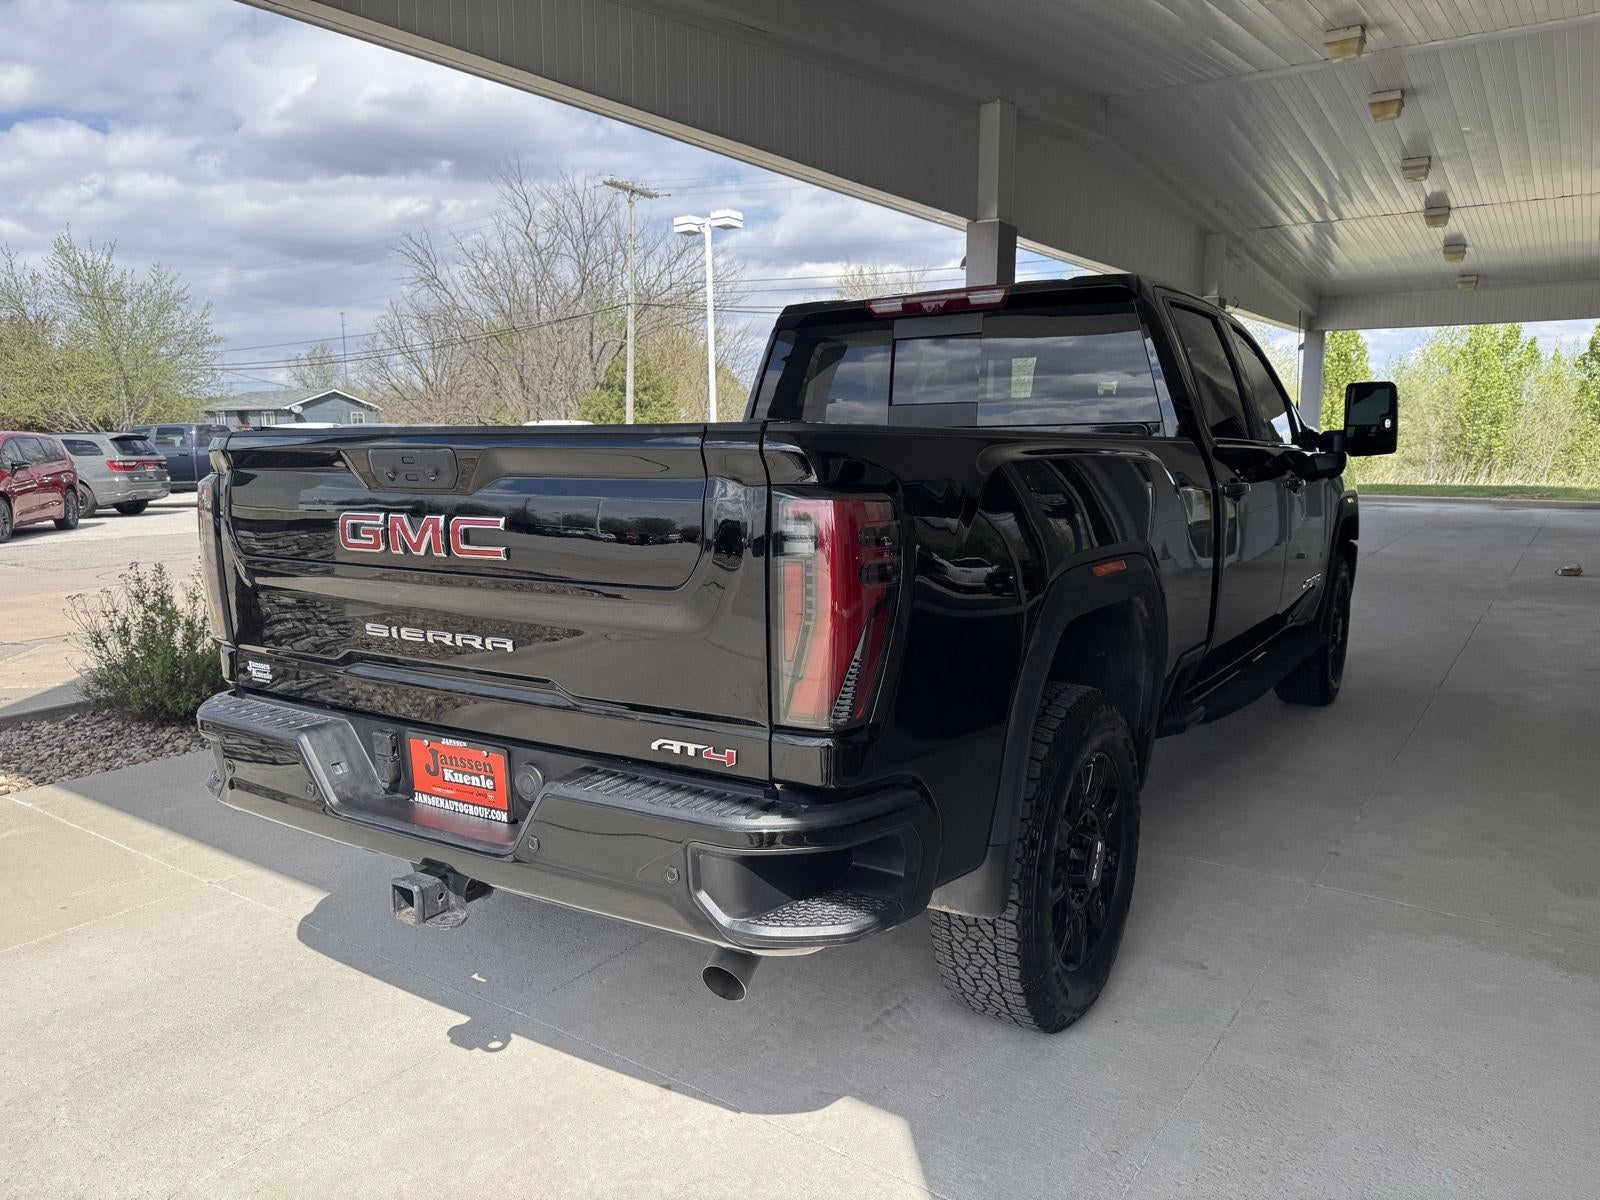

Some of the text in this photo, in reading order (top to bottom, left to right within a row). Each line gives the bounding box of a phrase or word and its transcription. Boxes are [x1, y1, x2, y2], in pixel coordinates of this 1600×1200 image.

[339, 512, 511, 560] GMC
[365, 622, 516, 653] SIERRA
[441, 738, 467, 747] JANSSEN
[651, 738, 738, 767] AT4
[425, 748, 494, 776] Janssen
[443, 768, 494, 789] Kuenle
